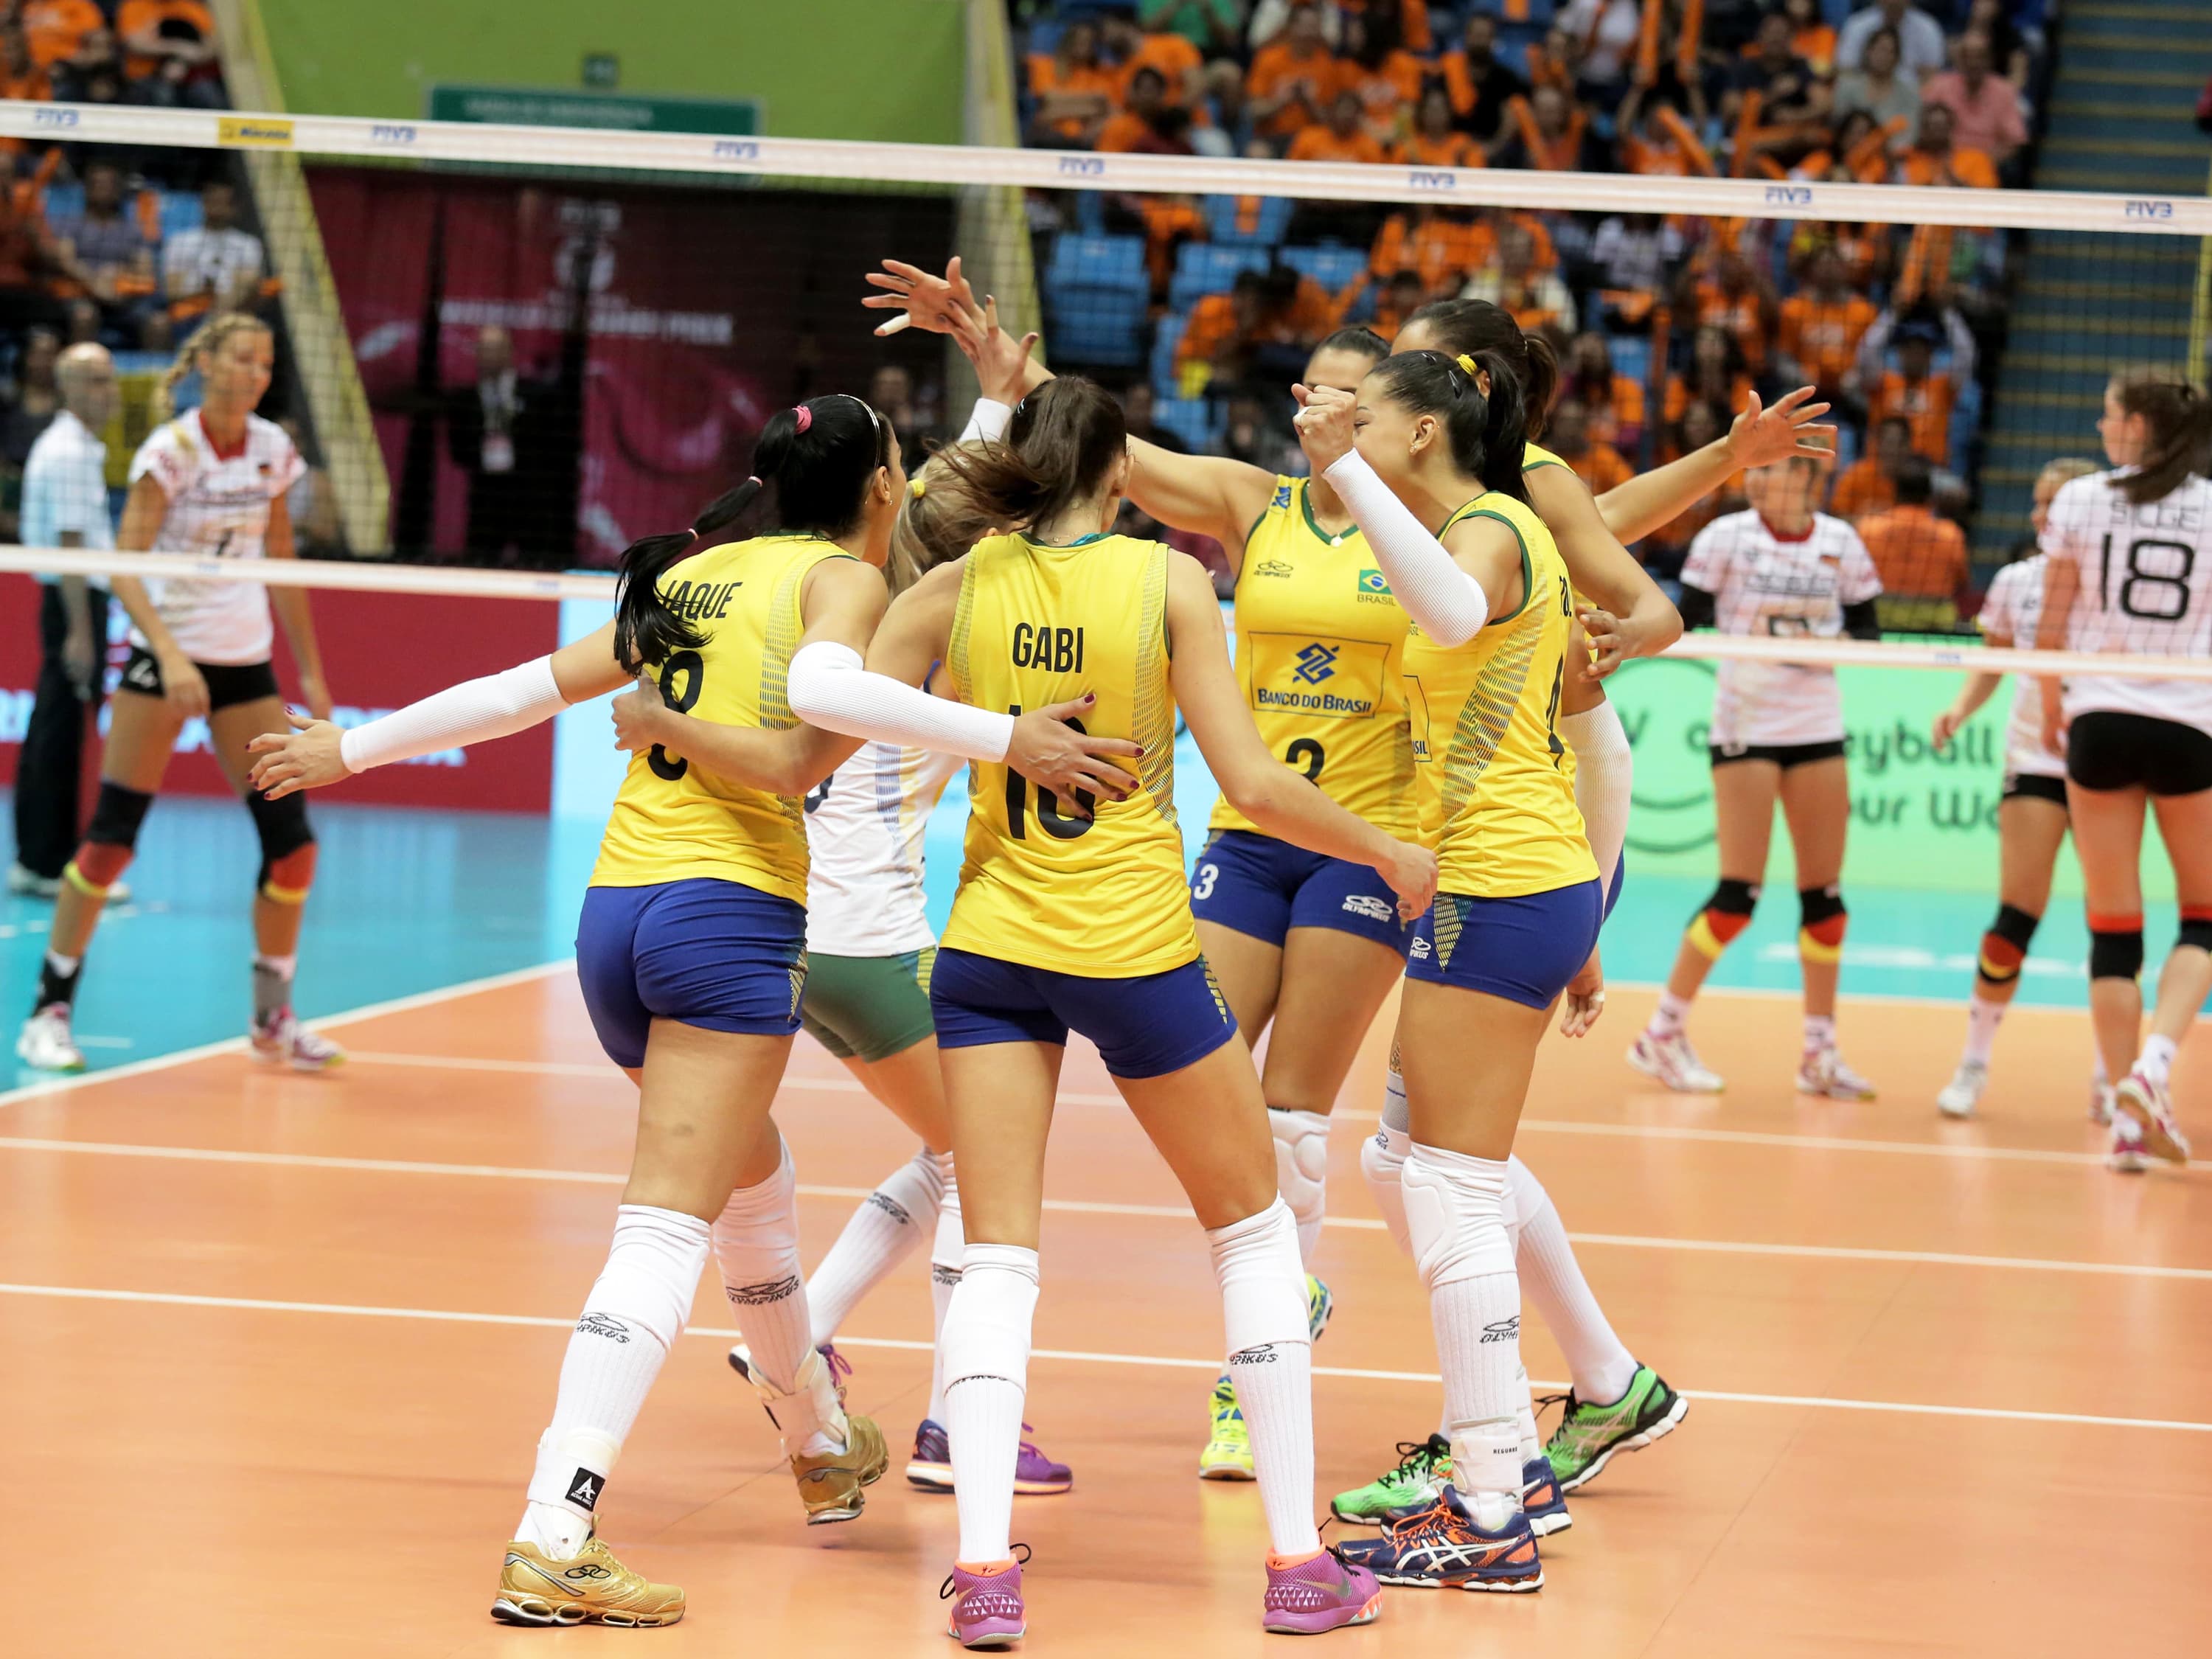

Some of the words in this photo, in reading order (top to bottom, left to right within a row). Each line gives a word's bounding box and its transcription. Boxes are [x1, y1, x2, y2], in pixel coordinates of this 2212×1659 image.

[2100, 532, 2195, 622] 18
[1357, 594, 1397, 607] BRASIL
[1012, 622, 1084, 674] GABI
[647, 650, 705, 782] 8
[1257, 688, 1299, 706] BANCO
[1301, 694, 1321, 709] DO
[1193, 863, 1219, 900] 3
[1342, 902, 1390, 922] OLYMPIKUS
